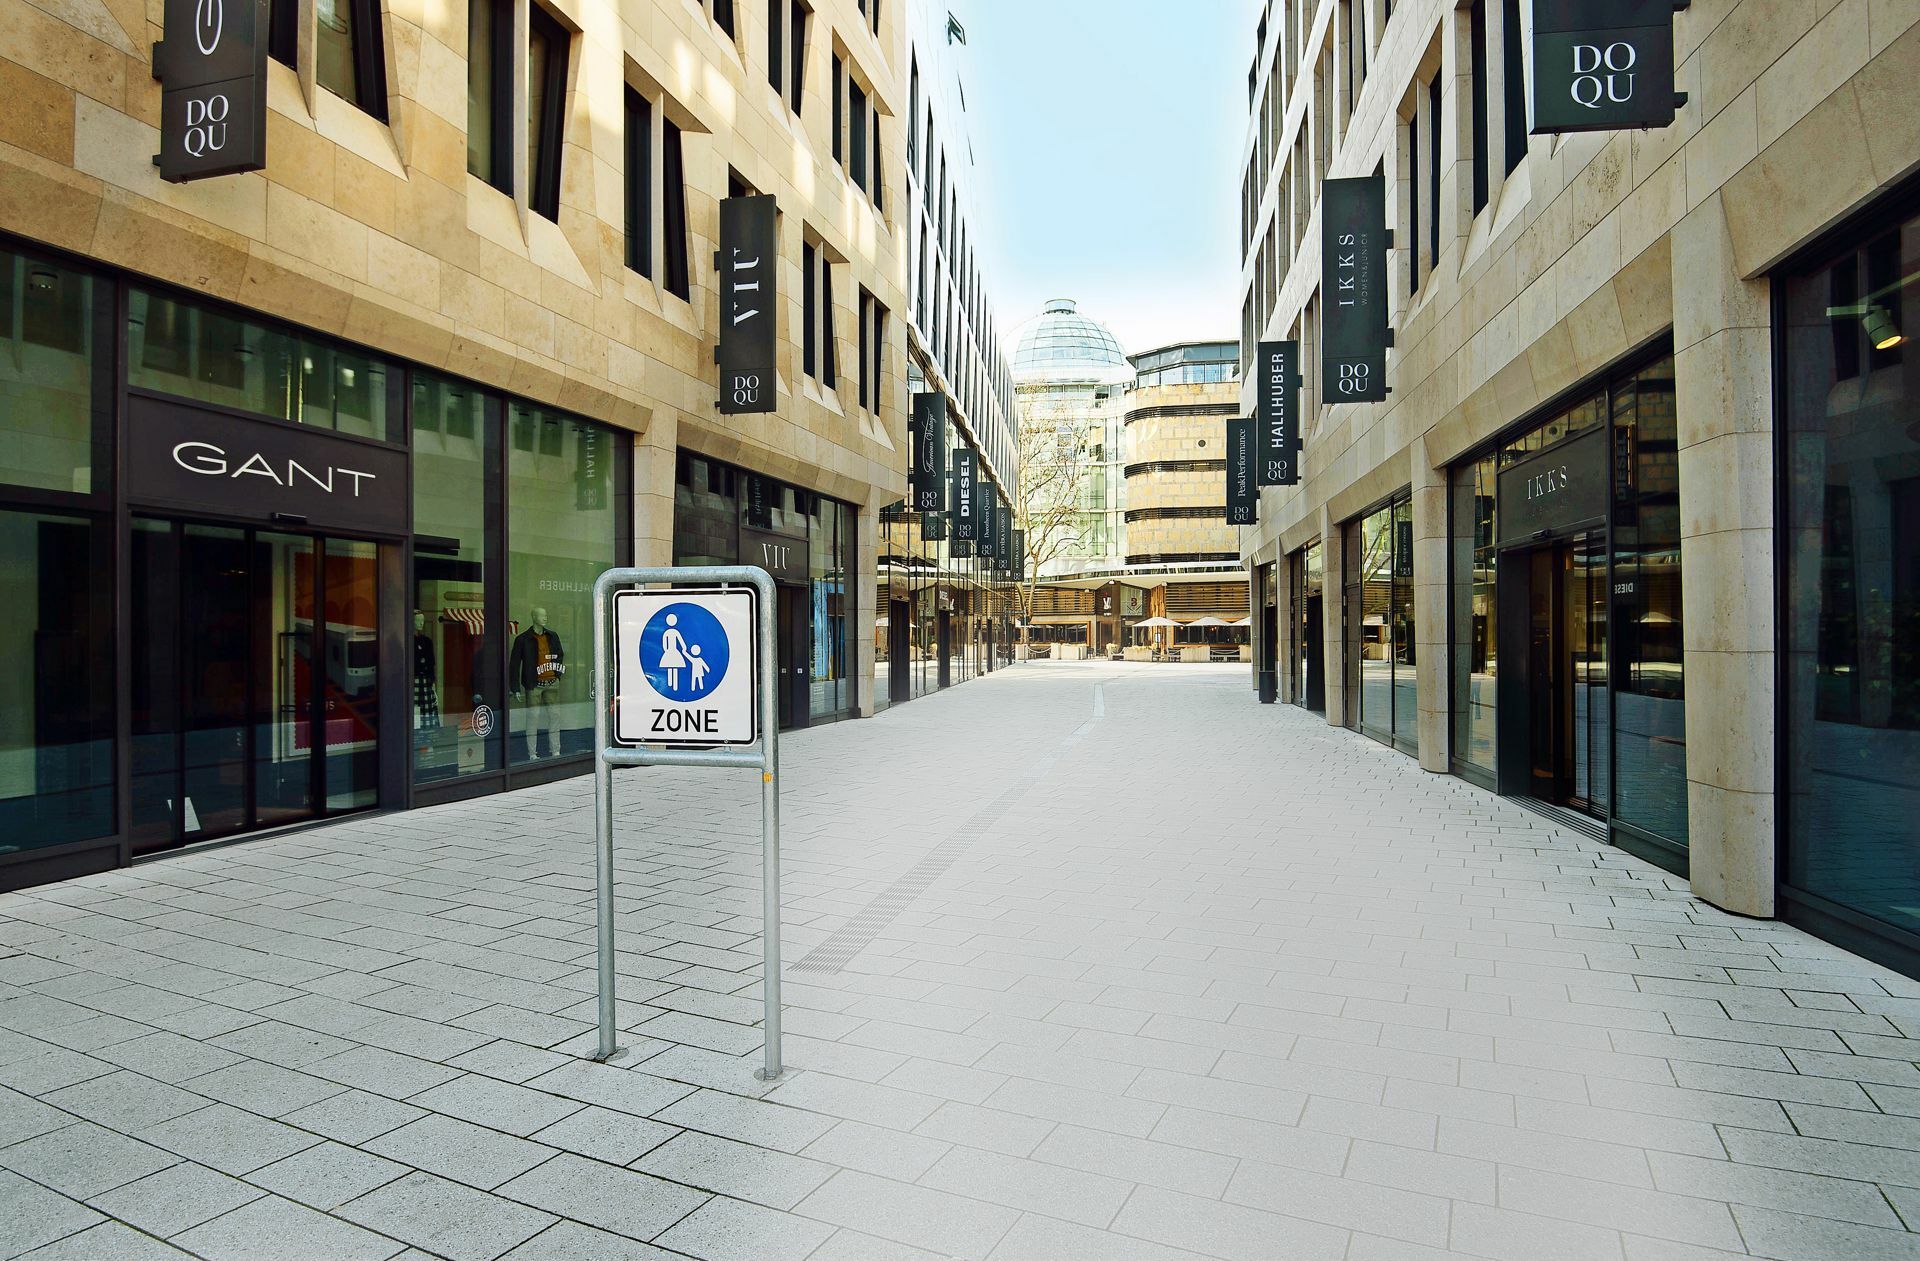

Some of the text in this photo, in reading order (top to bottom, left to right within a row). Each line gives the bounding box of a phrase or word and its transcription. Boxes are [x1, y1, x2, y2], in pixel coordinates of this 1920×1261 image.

[1572, 42, 1636, 74] DO
[1571, 73, 1636, 109] QU
[187, 95, 229, 126] DO
[184, 123, 228, 157] QU
[1339, 234, 1355, 307] IKKS
[734, 247, 759, 327] VIU
[734, 375, 760, 390] DO
[1341, 363, 1369, 378] DO
[733, 389, 759, 405] QU
[1339, 378, 1368, 394] QU
[1272, 353, 1284, 448] HALLHUBER
[172, 441, 376, 496] GANT
[1267, 470, 1287, 480] QU
[1268, 460, 1287, 470] DO
[923, 491, 937, 499] DO
[961, 456, 970, 517] DIESEL
[1527, 465, 1567, 500] IKKS
[921, 499, 937, 508] QU
[1235, 506, 1249, 514] DO
[1234, 513, 1248, 521] QU
[761, 543, 791, 570] VIU
[651, 709, 719, 733] ZONE
